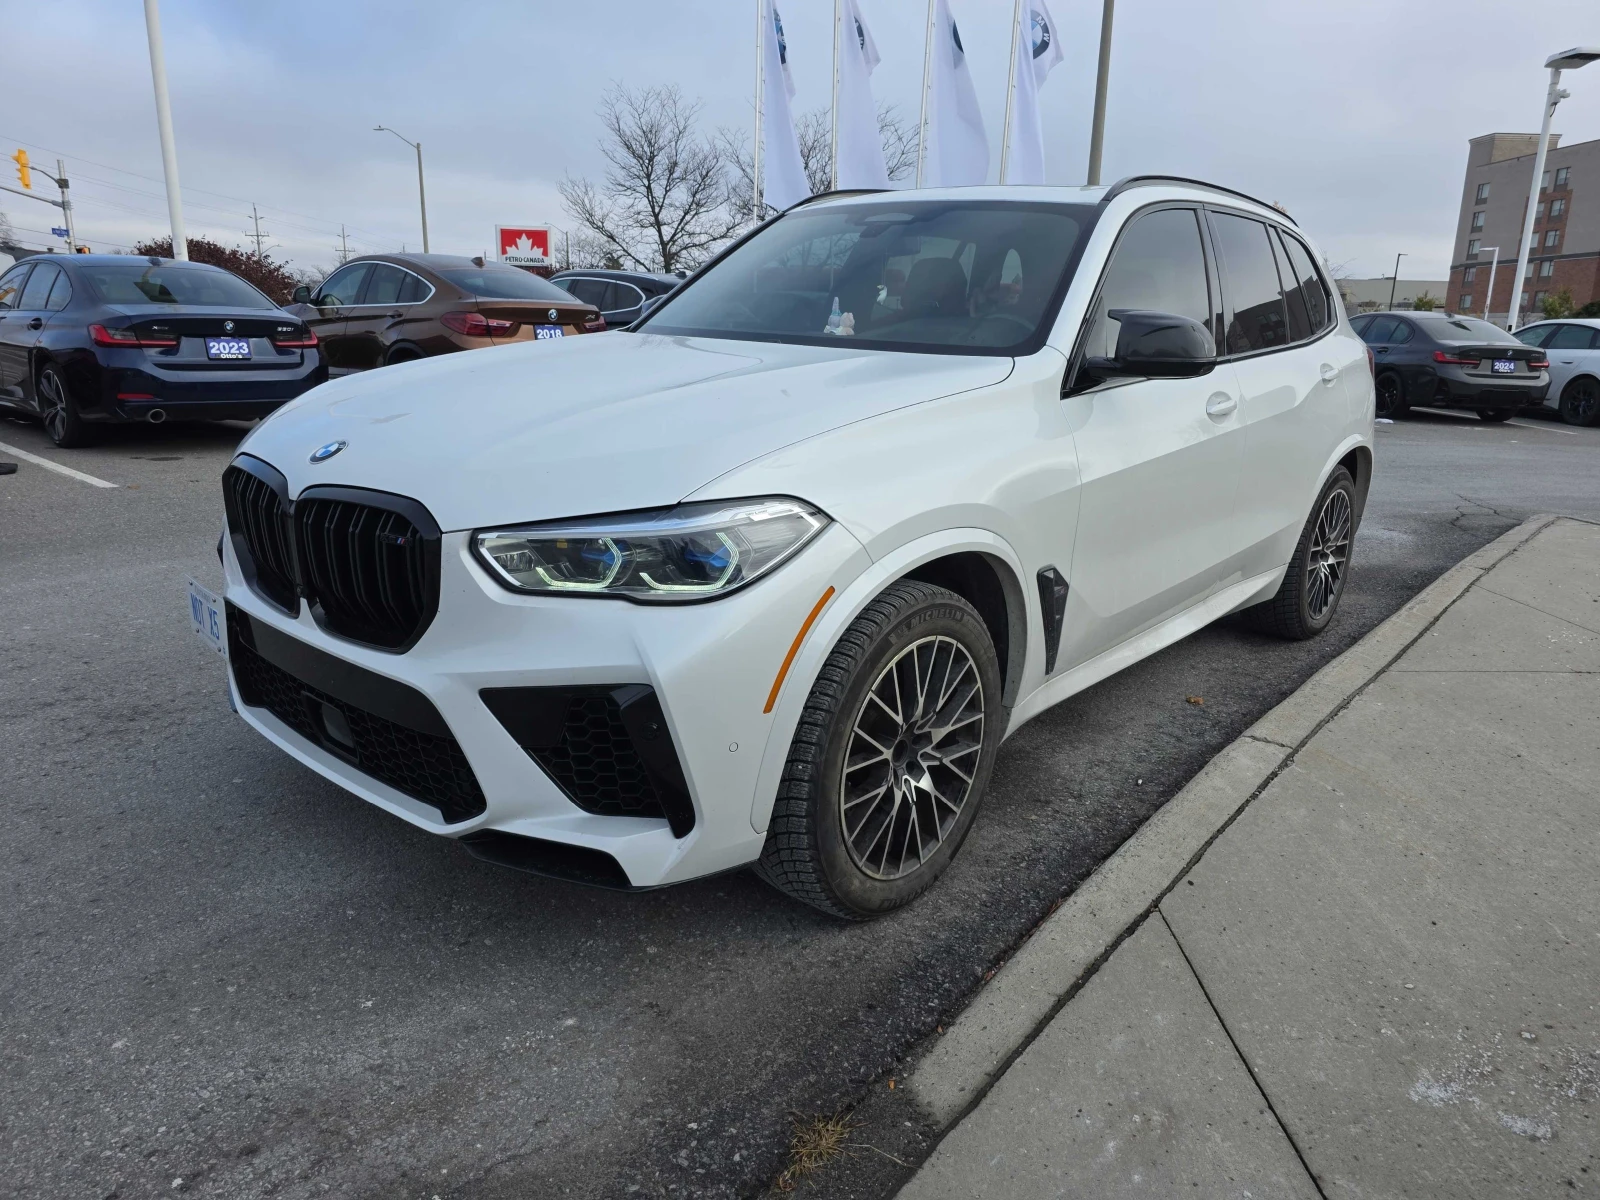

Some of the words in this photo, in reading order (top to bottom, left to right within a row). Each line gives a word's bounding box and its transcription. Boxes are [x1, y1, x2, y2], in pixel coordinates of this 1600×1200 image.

[536, 329, 562, 339] 2018
[209, 341, 249, 354] 2023
[1494, 362, 1515, 370] 2024
[910, 608, 965, 628] MICHELIN
